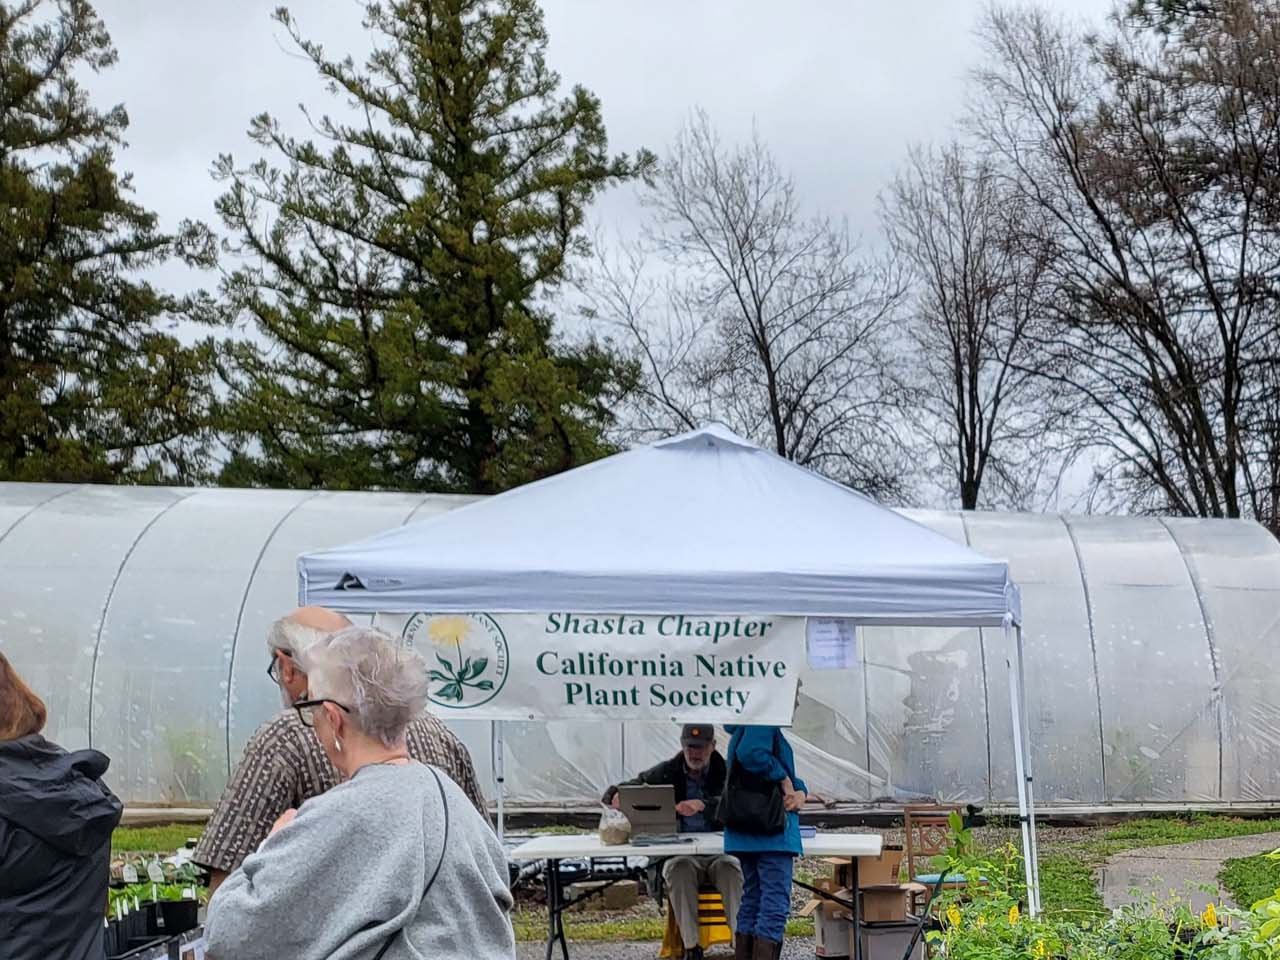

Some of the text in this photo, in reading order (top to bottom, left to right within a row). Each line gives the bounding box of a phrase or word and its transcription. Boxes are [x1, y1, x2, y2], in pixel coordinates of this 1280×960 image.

[545, 612, 773, 643] Shasta Chapter
[536, 651, 786, 678] California Native
[566, 683, 750, 713] Plant Society
